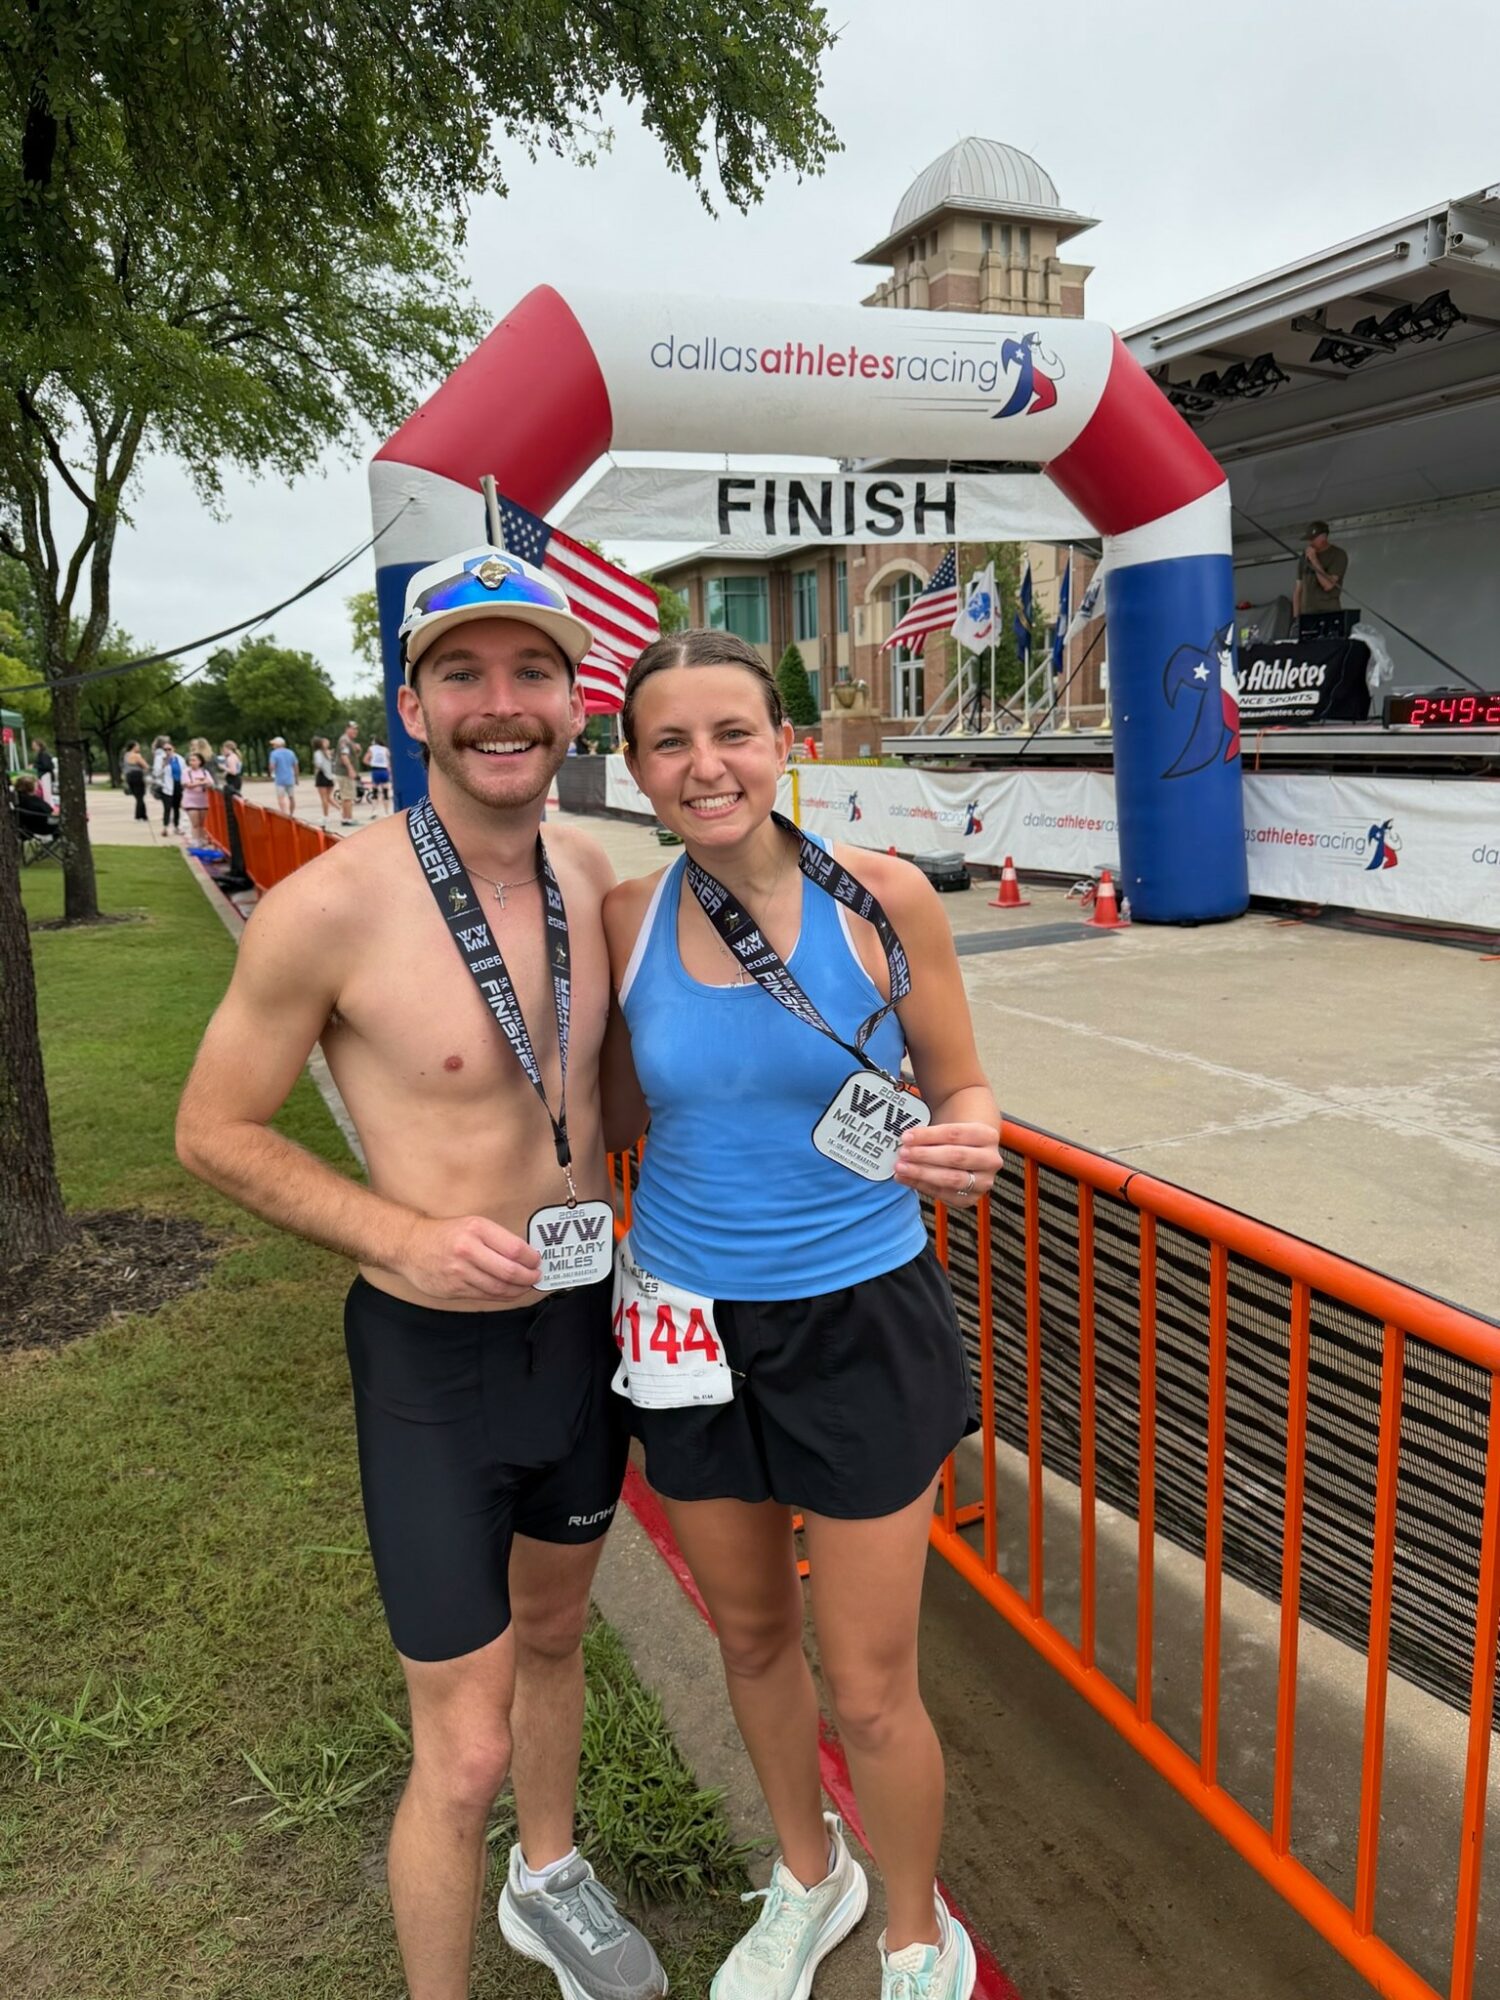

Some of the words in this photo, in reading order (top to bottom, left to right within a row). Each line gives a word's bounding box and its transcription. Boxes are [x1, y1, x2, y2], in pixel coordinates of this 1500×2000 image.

[651, 334, 998, 392] dallasathletesracing
[718, 478, 956, 536] FINISH
[1246, 658, 1327, 691] Athletes
[1239, 697, 1264, 705] NCE
[1268, 694, 1313, 704] SPORTS
[431, 827, 461, 875] MARATHON
[860, 892, 874, 917] 2026
[464, 935, 490, 953] MM
[469, 954, 503, 973] 2026
[745, 952, 778, 970] 2026
[499, 976, 510, 989] 5K
[504, 991, 517, 1008] 10K
[480, 979, 539, 1084] FINISHER
[511, 1010, 525, 1032] HALF
[880, 1086, 906, 1107] 2026
[850, 1083, 922, 1137] WW
[833, 1107, 904, 1153] MILITARY
[837, 1127, 884, 1159] MILES
[558, 1208, 585, 1220] 2026
[536, 1216, 606, 1246] WW
[538, 1241, 606, 1260] MILITARY
[549, 1255, 593, 1272] MILES
[613, 1298, 719, 1364] 4144
